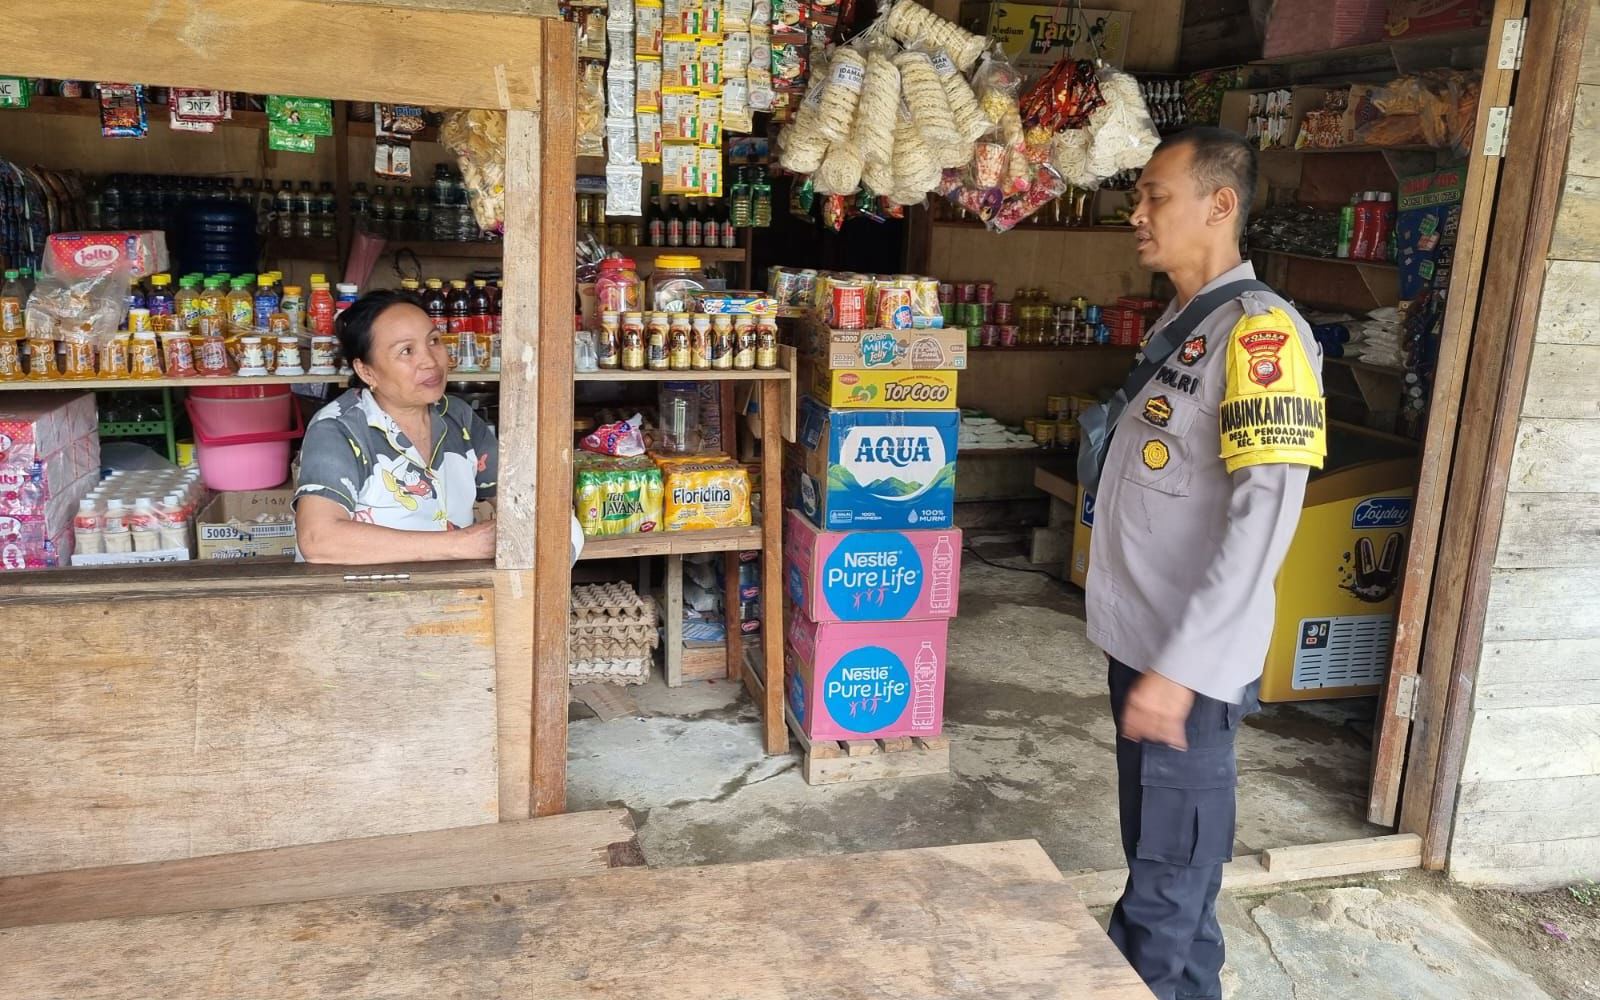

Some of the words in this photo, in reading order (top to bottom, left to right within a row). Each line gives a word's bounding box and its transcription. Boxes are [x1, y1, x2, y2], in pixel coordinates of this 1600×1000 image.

[80, 248, 113, 265] jolly
[1155, 366, 1199, 395] POLRI
[1229, 430, 1249, 442] DESA
[1254, 426, 1315, 439] PENGADANG
[1237, 438, 1255, 449] KEC.
[1260, 436, 1306, 446] SEKAYAM
[855, 436, 931, 467] AQUA
[673, 486, 731, 504] Floridina
[602, 501, 645, 519] JAVANA
[1357, 501, 1409, 524] Joyday
[844, 551, 898, 568] Nestlé
[828, 568, 878, 588] Pure
[881, 566, 916, 594] Life
[842, 666, 889, 681] Nestlé
[828, 681, 872, 699] Pure
[874, 680, 905, 703] Life
